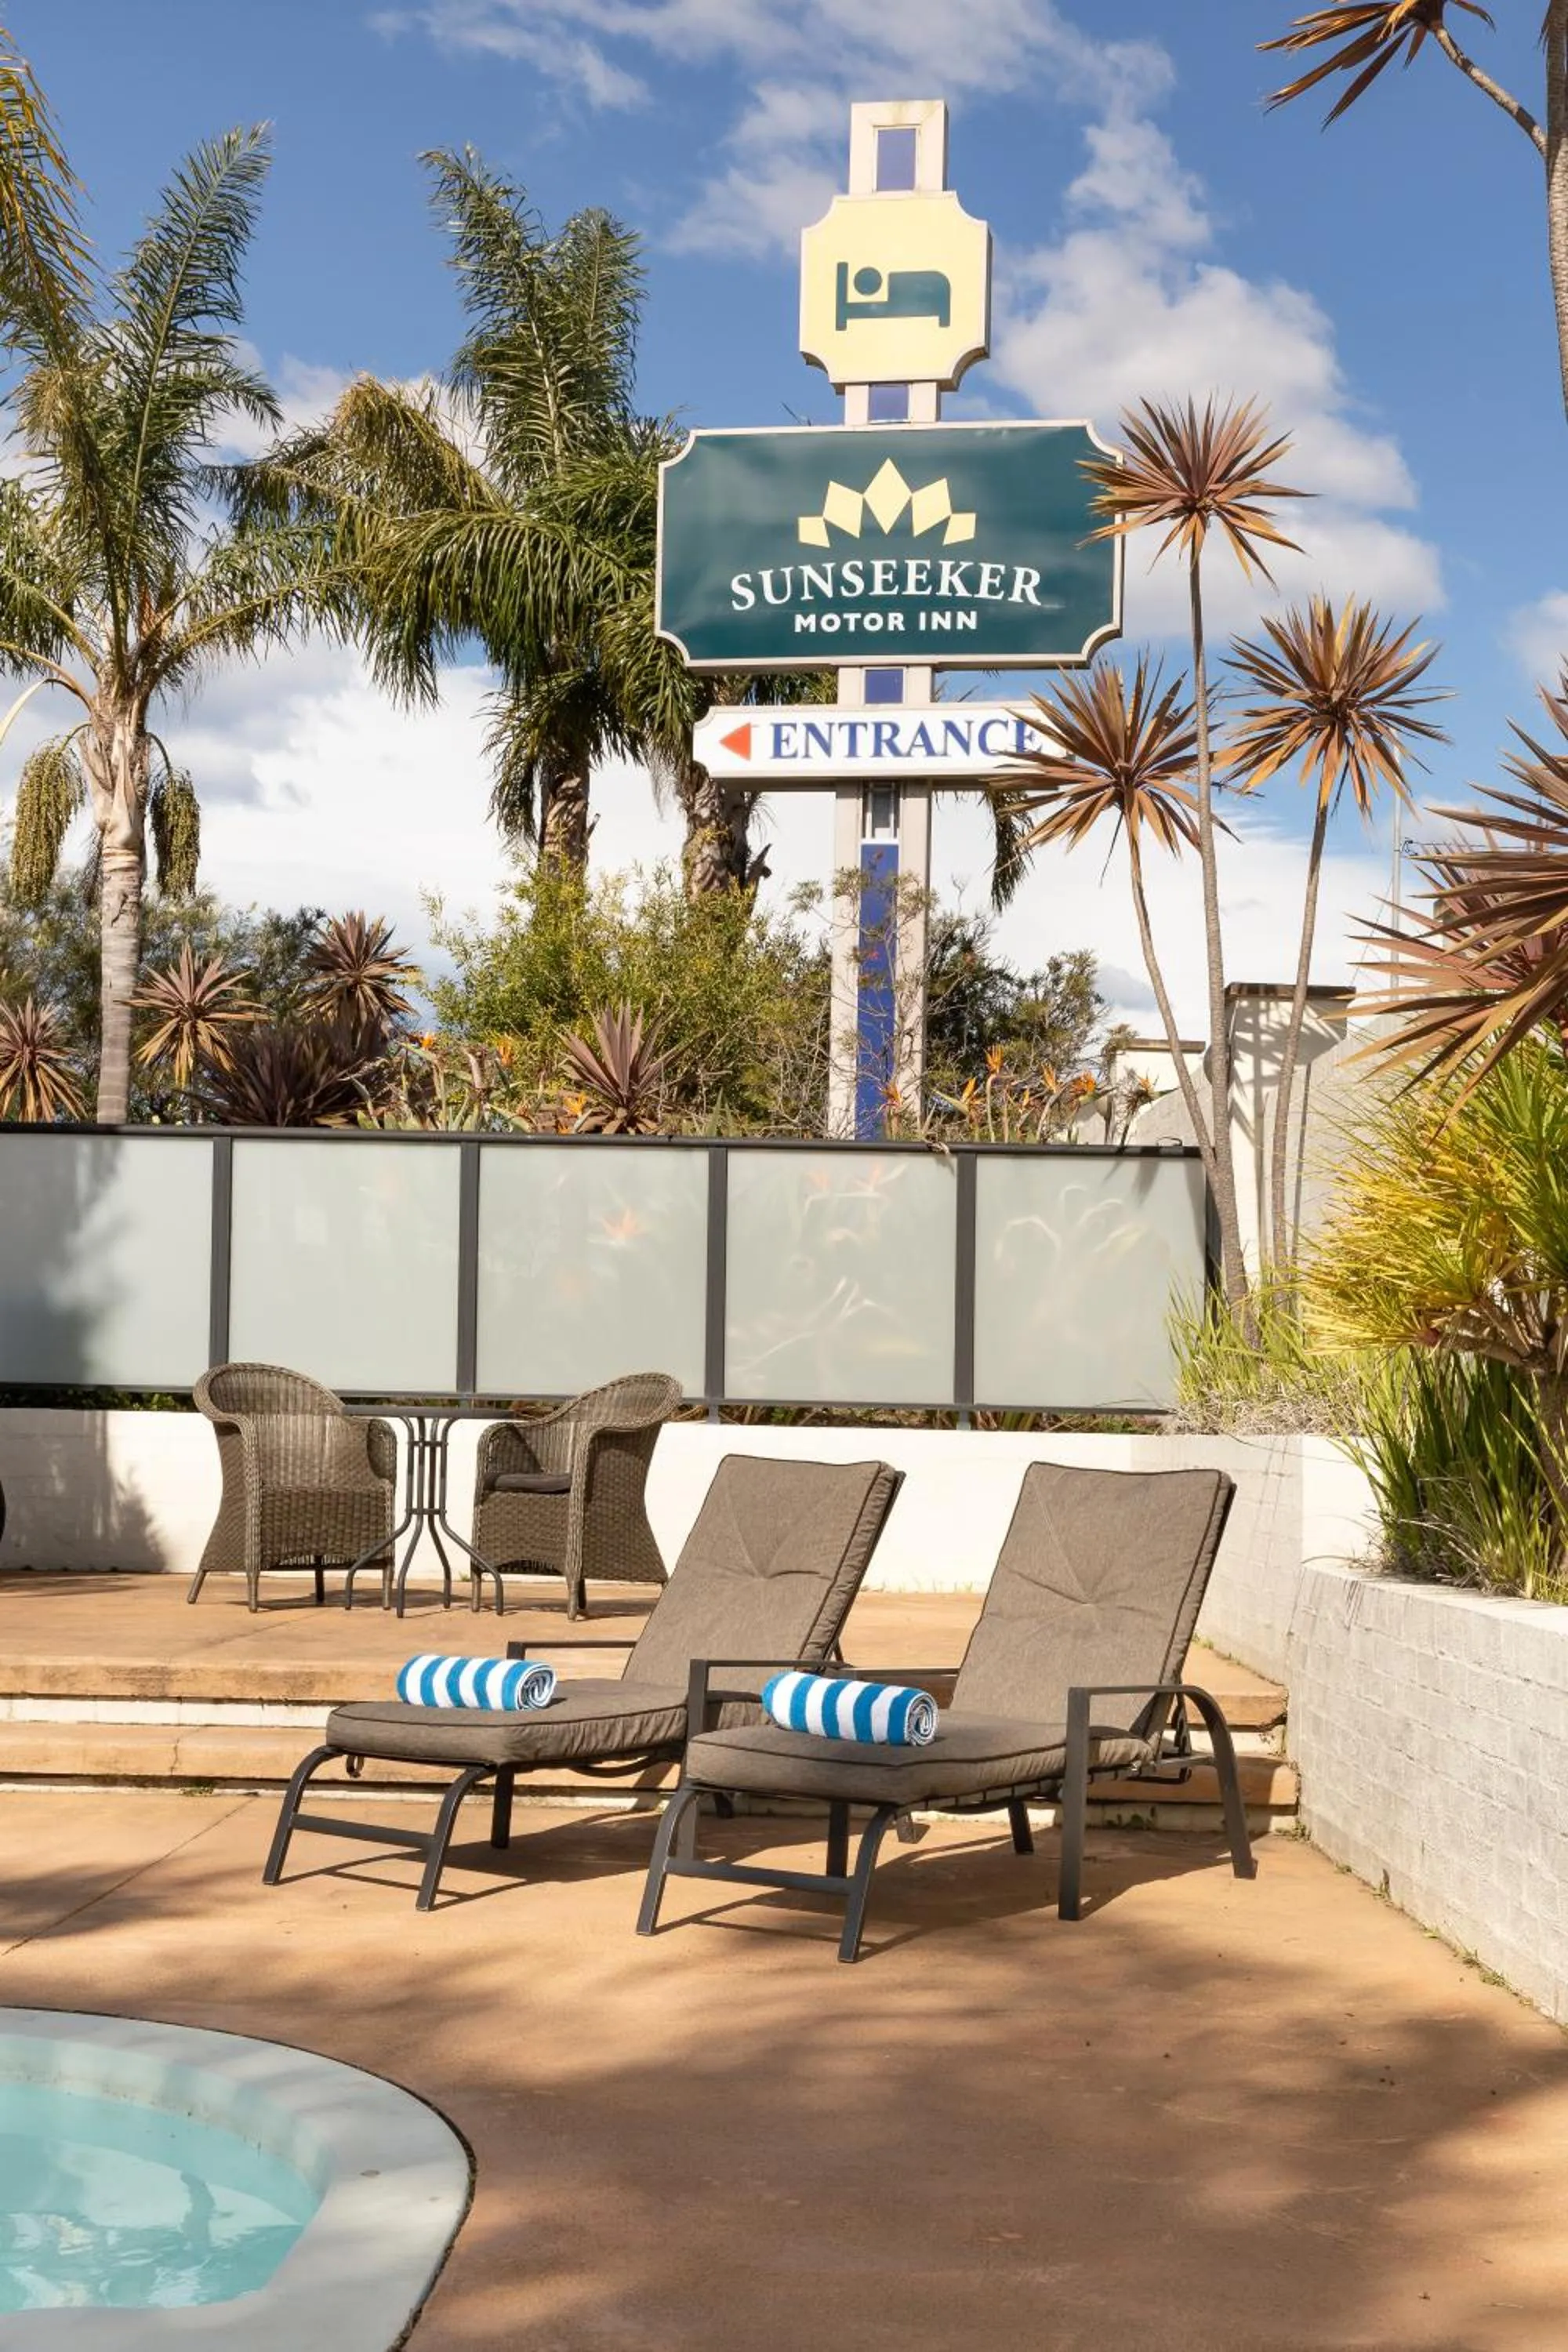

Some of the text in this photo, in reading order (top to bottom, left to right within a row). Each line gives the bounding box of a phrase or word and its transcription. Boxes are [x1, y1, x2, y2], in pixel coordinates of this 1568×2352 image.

[730, 558, 1042, 611] SUNSEEKER
[794, 611, 978, 633] MOTOR INN
[771, 718, 1043, 760] ENTRANCE
